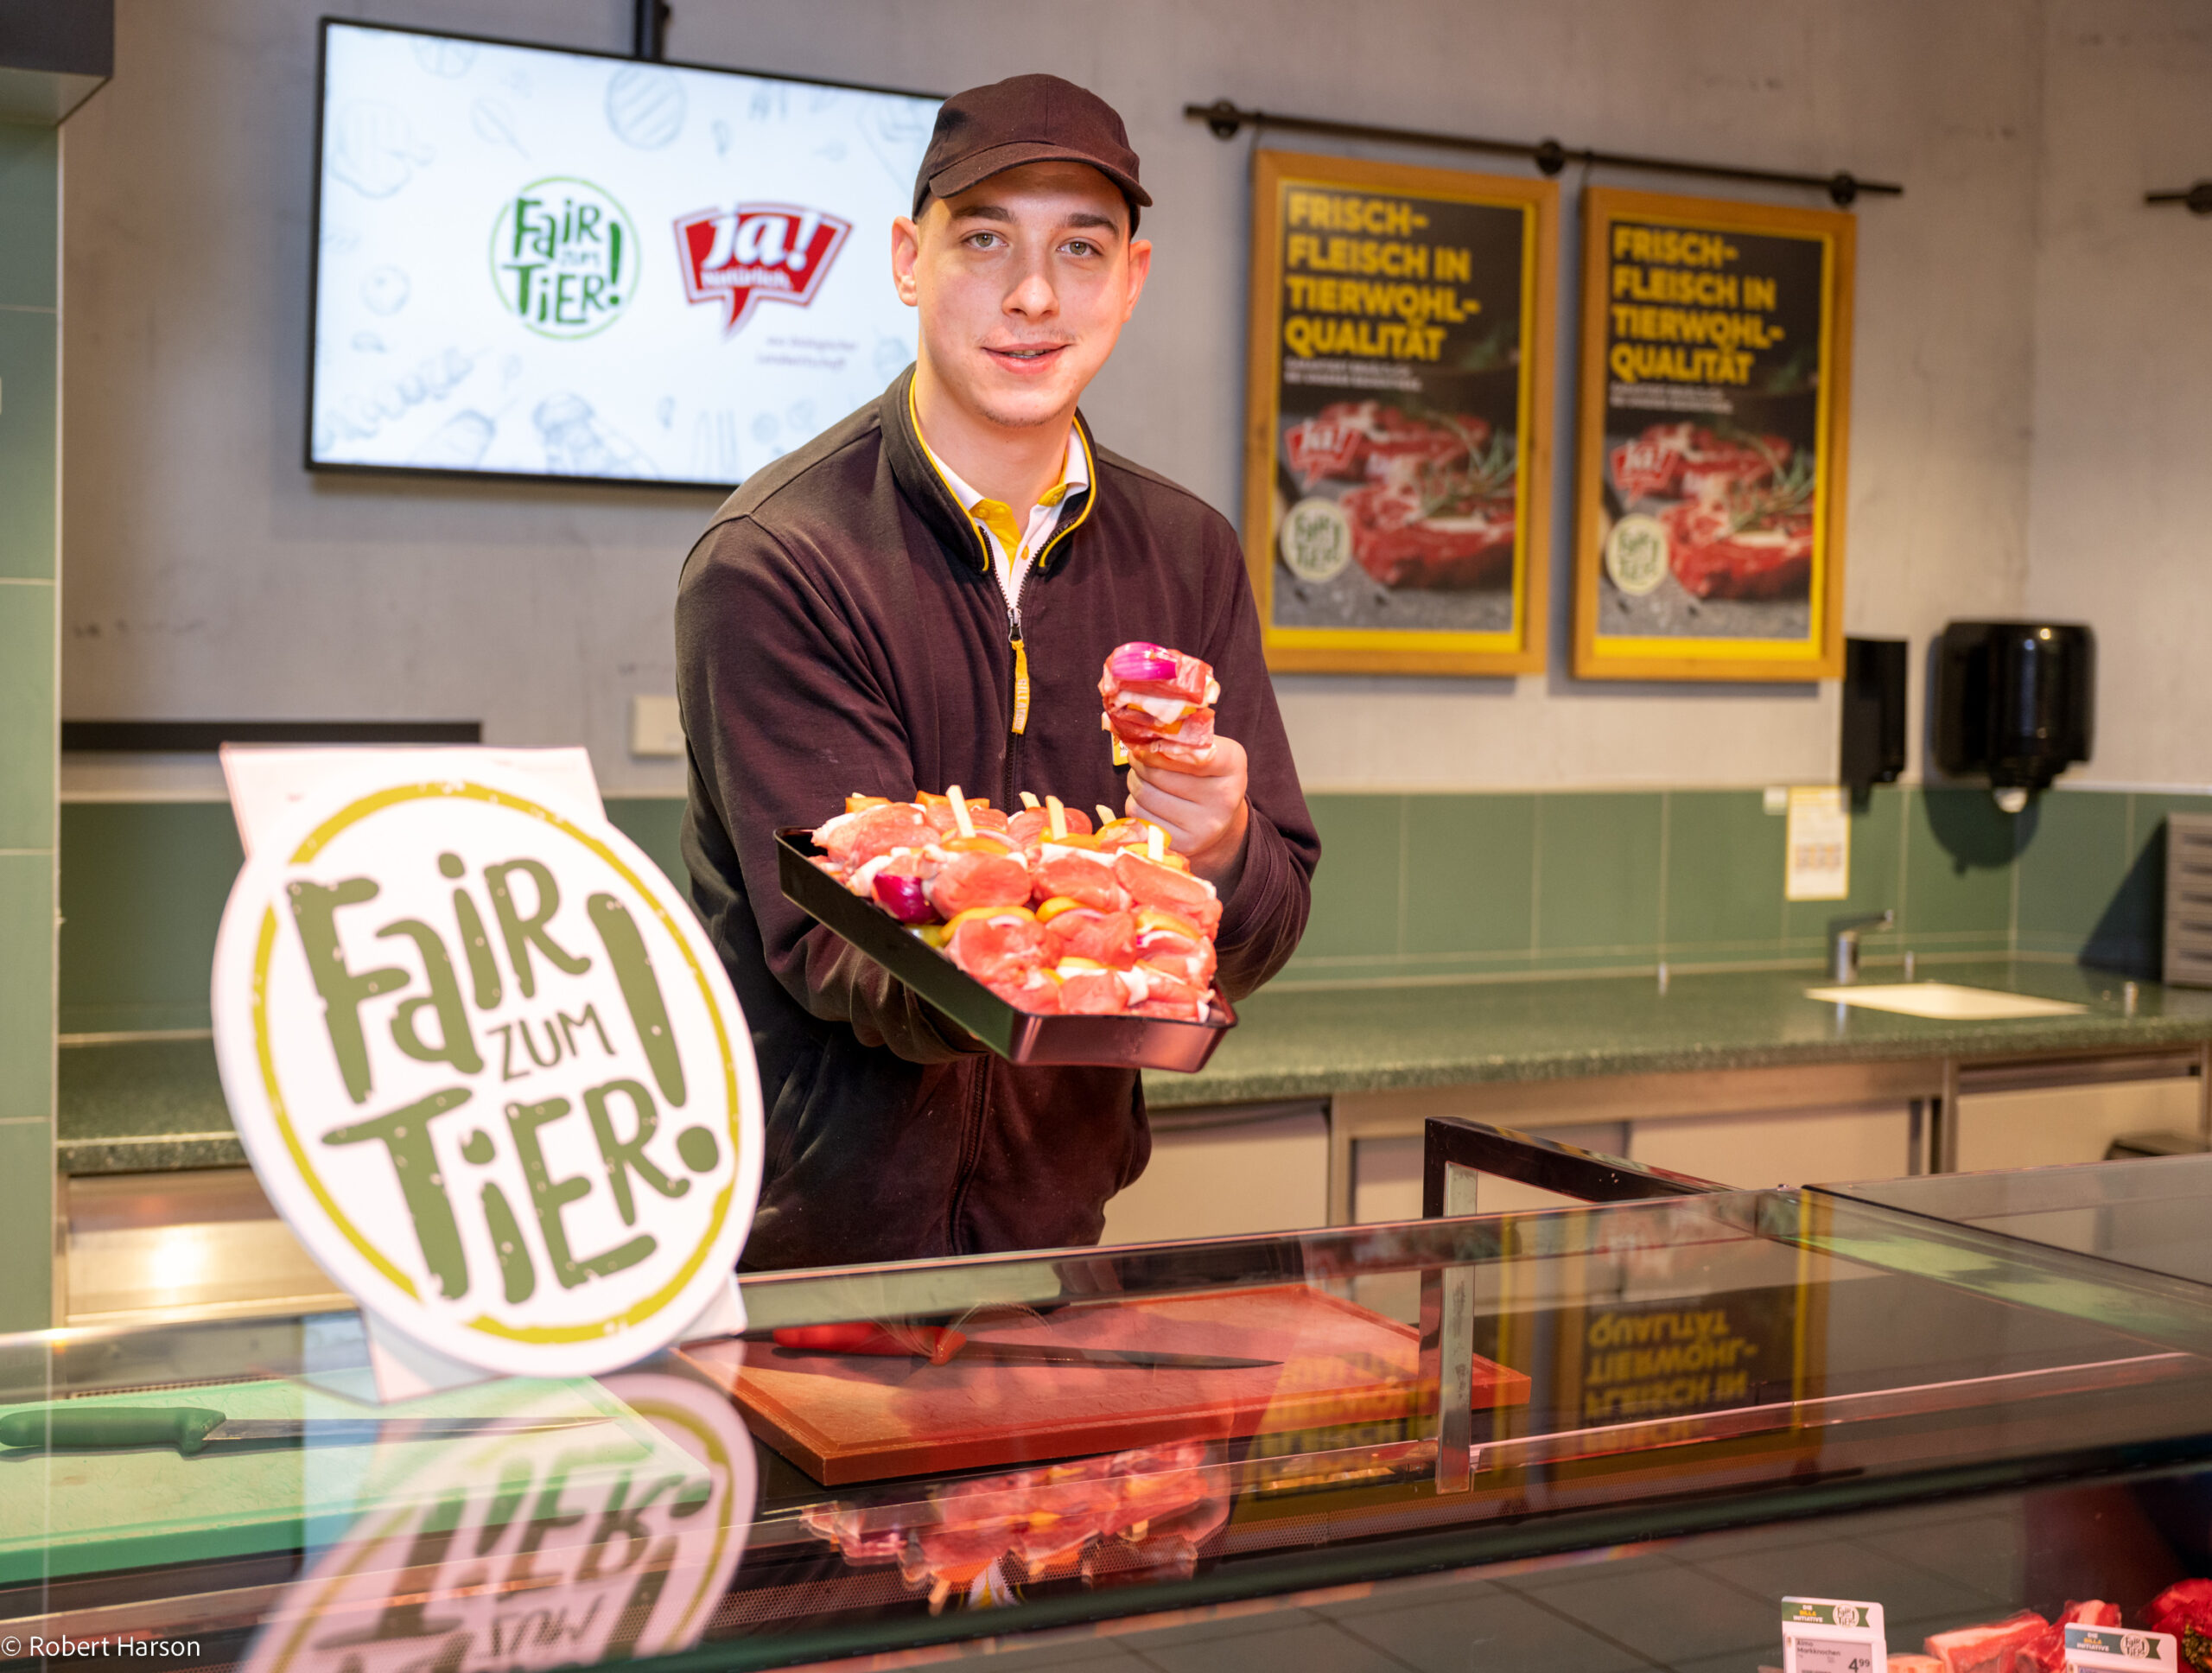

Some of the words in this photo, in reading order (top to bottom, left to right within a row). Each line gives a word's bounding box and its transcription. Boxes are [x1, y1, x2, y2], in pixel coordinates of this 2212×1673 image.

[1288, 190, 1429, 237] FRISCH-
[701, 210, 823, 271] ja!
[1287, 232, 1428, 279] FLEISCH
[1433, 245, 1472, 283] IN
[1612, 225, 1739, 270] FRISCH-
[1286, 273, 1482, 324] TIERWOHL-
[1612, 264, 1738, 309] FLEISCH
[1742, 275, 1777, 311] IN
[1284, 315, 1448, 362] QUALITÄT
[1612, 303, 1786, 349] TIERWOHL-
[1611, 342, 1755, 386] QUALITÄT
[486, 1002, 617, 1082] ZUM
